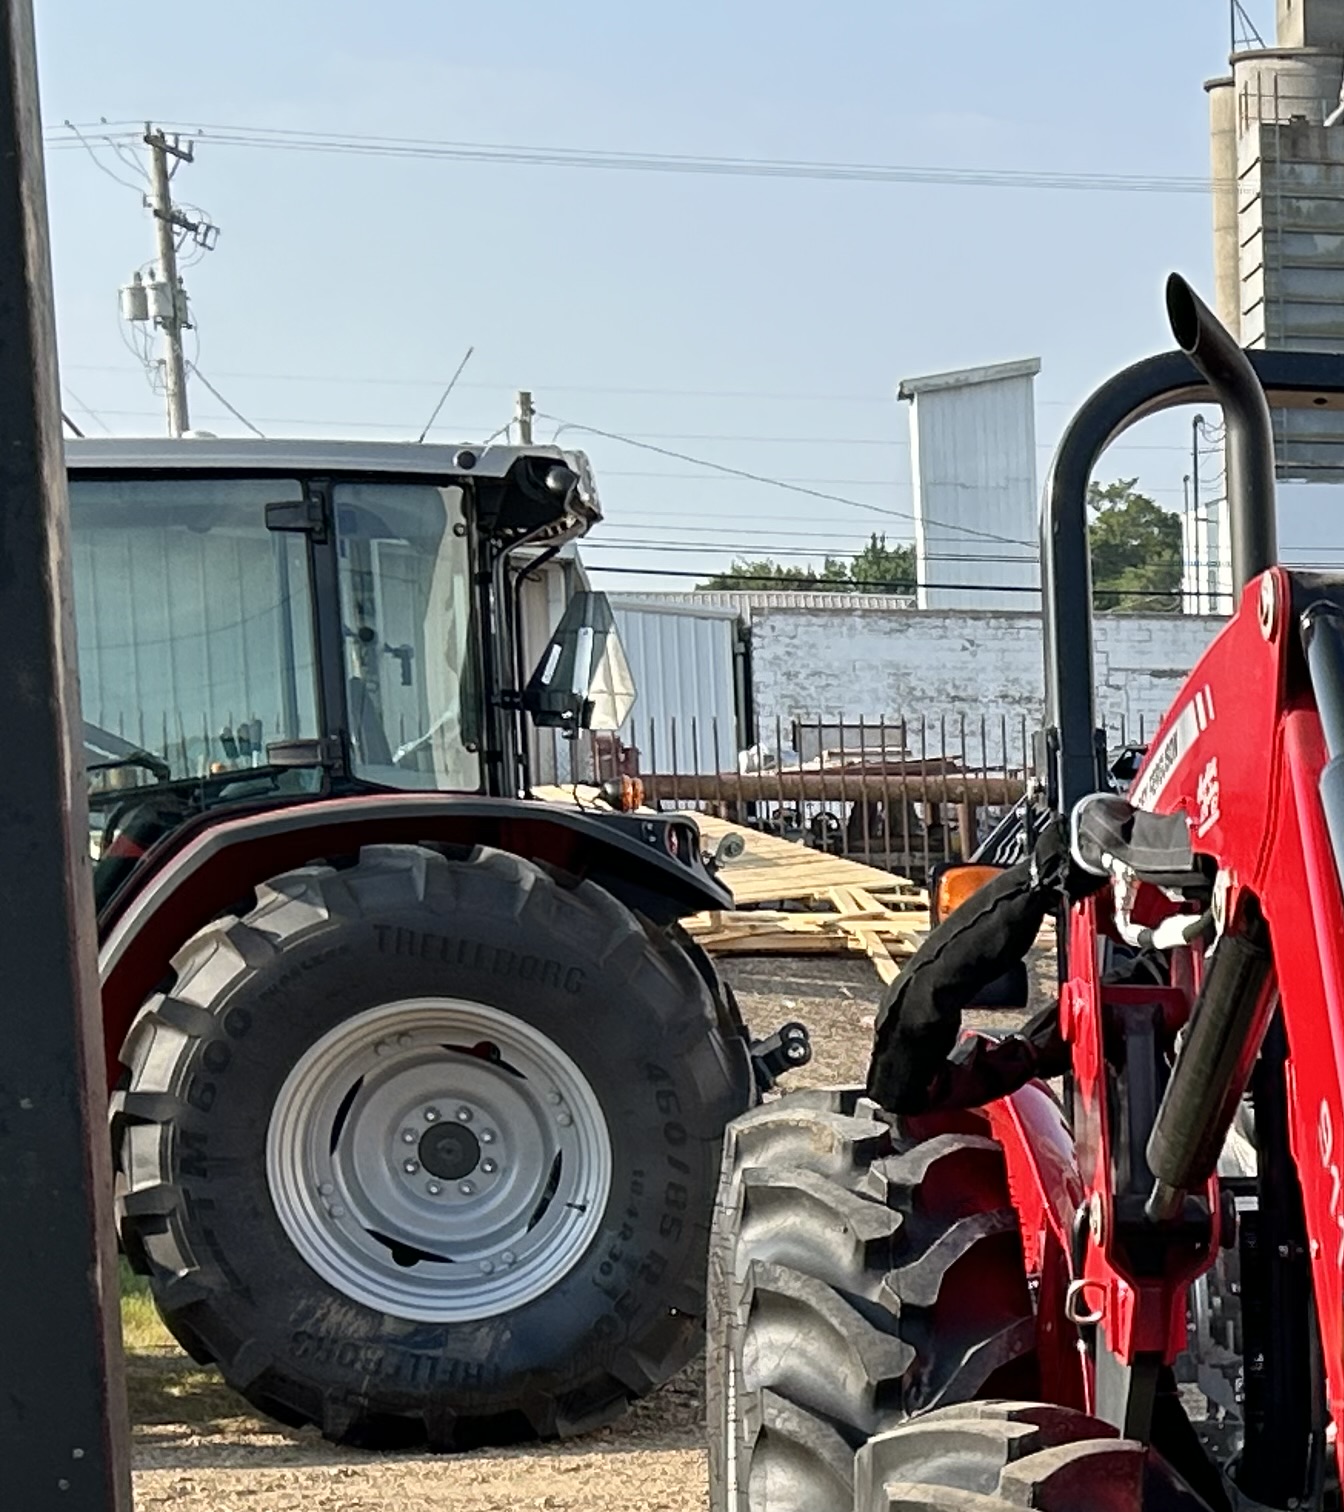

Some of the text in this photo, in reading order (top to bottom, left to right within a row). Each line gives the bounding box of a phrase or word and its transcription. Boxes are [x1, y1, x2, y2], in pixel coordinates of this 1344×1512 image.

[373, 924, 587, 994] TRELLEBORG
[181, 1006, 254, 1223] TM 600
